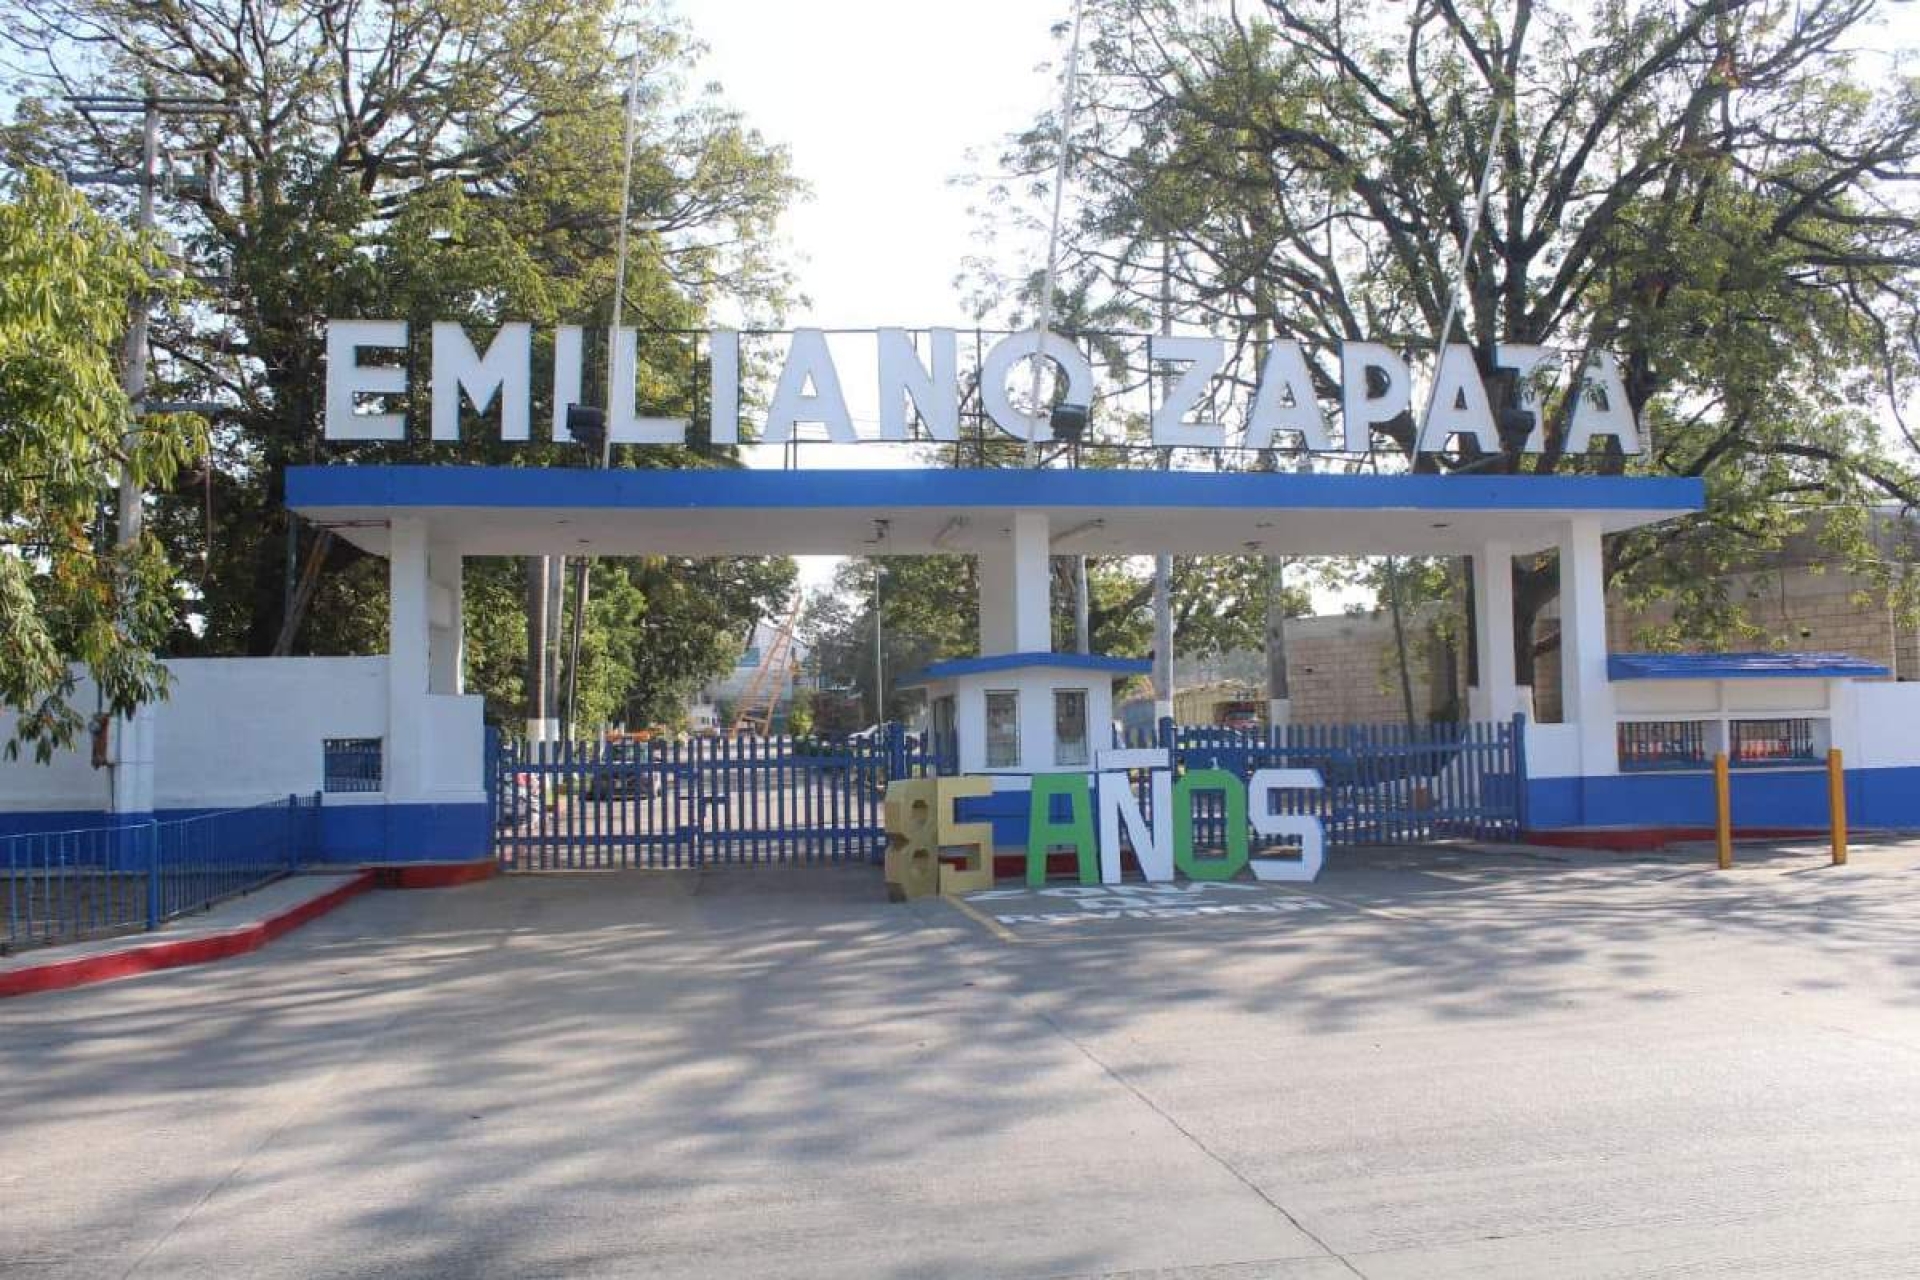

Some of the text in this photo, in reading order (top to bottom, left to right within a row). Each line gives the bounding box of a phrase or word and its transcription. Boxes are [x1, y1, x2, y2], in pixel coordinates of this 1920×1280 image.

[325, 320, 1641, 454] EMILIANO ZAPATA
[884, 748, 1325, 898] 85 AÑOS
